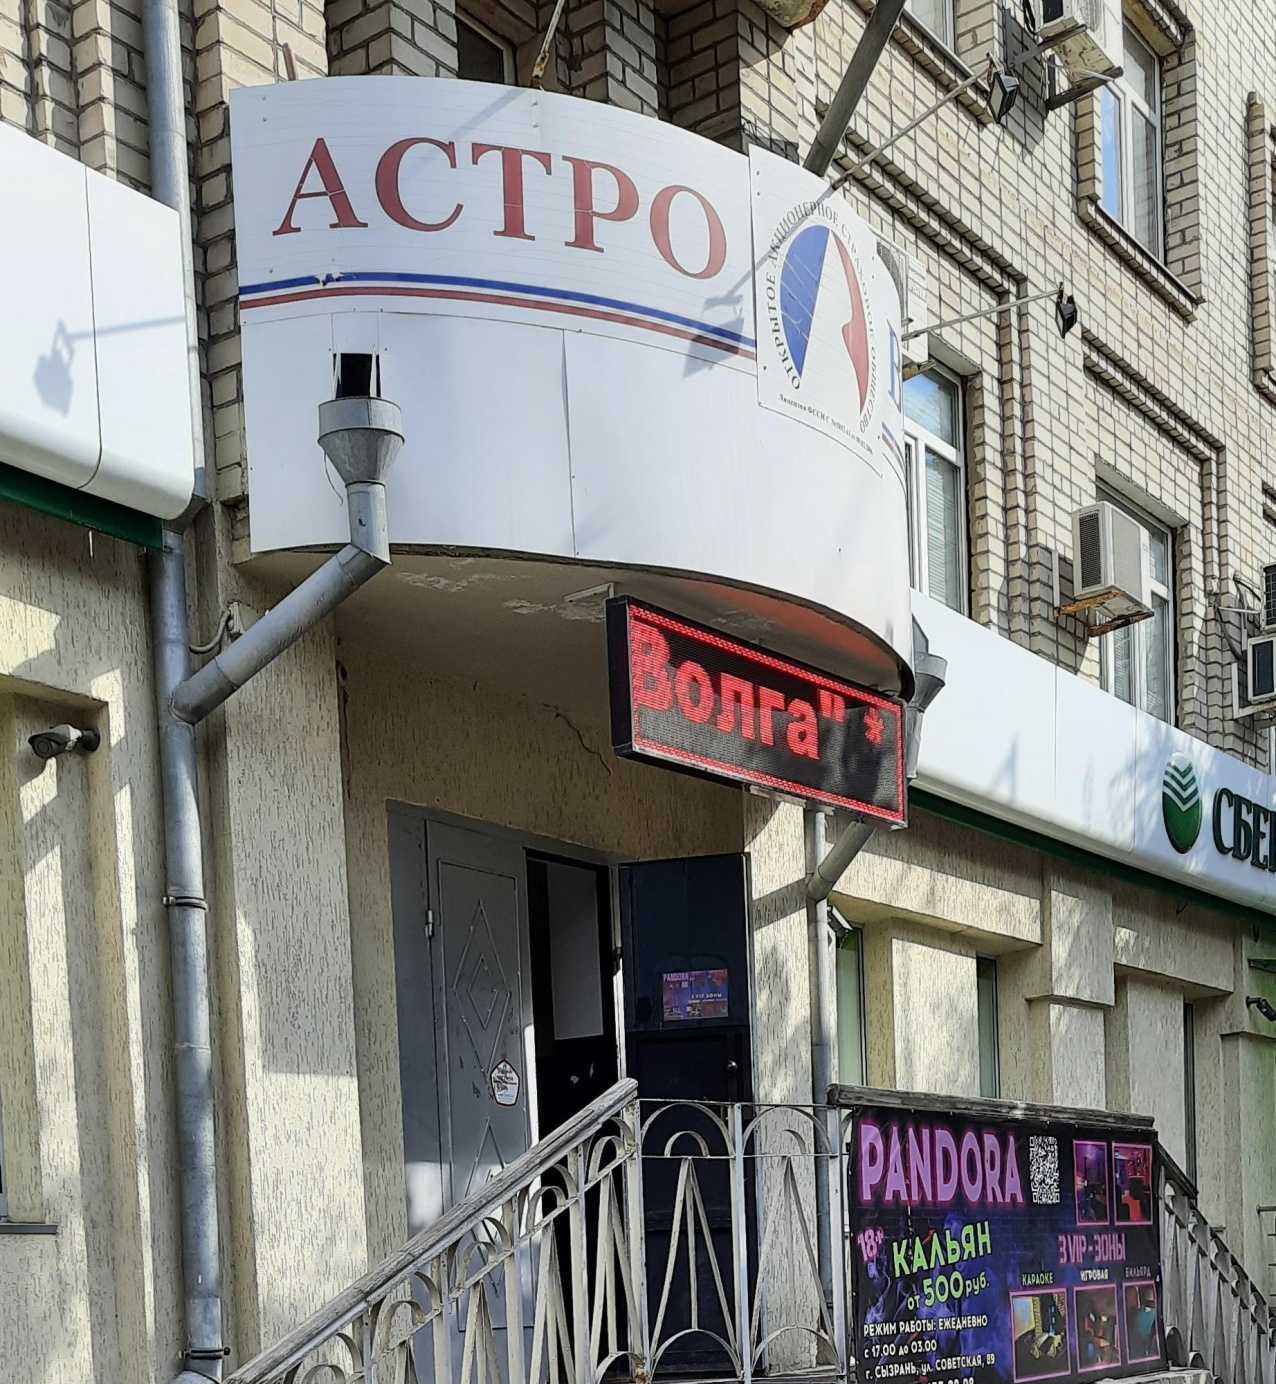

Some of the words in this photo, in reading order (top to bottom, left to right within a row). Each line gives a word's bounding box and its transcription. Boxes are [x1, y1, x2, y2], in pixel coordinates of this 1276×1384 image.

[272, 137, 727, 280] АСТРО
[766, 272, 800, 390] ОТКРЫТОЕ
[630, 620, 846, 760] Волга"
[859, 1123, 1024, 1203] PANDORA
[857, 1228, 884, 1261] 18+
[892, 1221, 991, 1277] КАЛЬЯН
[907, 1294, 920, 1310] от
[923, 1271, 964, 1307] 500
[965, 1272, 990, 1297] руб.
[1022, 1272, 1054, 1286] КАРАОКЕ
[863, 1322, 897, 1337] РЕЖИМ
[900, 1319, 937, 1334] РАБОТЫ:
[939, 1315, 988, 1331] ЕЖЕДНЕВНО
[865, 1370, 873, 1380] г.
[874, 1361, 919, 1378] СЫЗРАНЬ,
[935, 1354, 985, 1371] СОВЕТСКАЯ,
[872, 1344, 896, 1357] 17.00
[898, 1346, 909, 1356] до
[911, 1340, 937, 1353] 03.00
